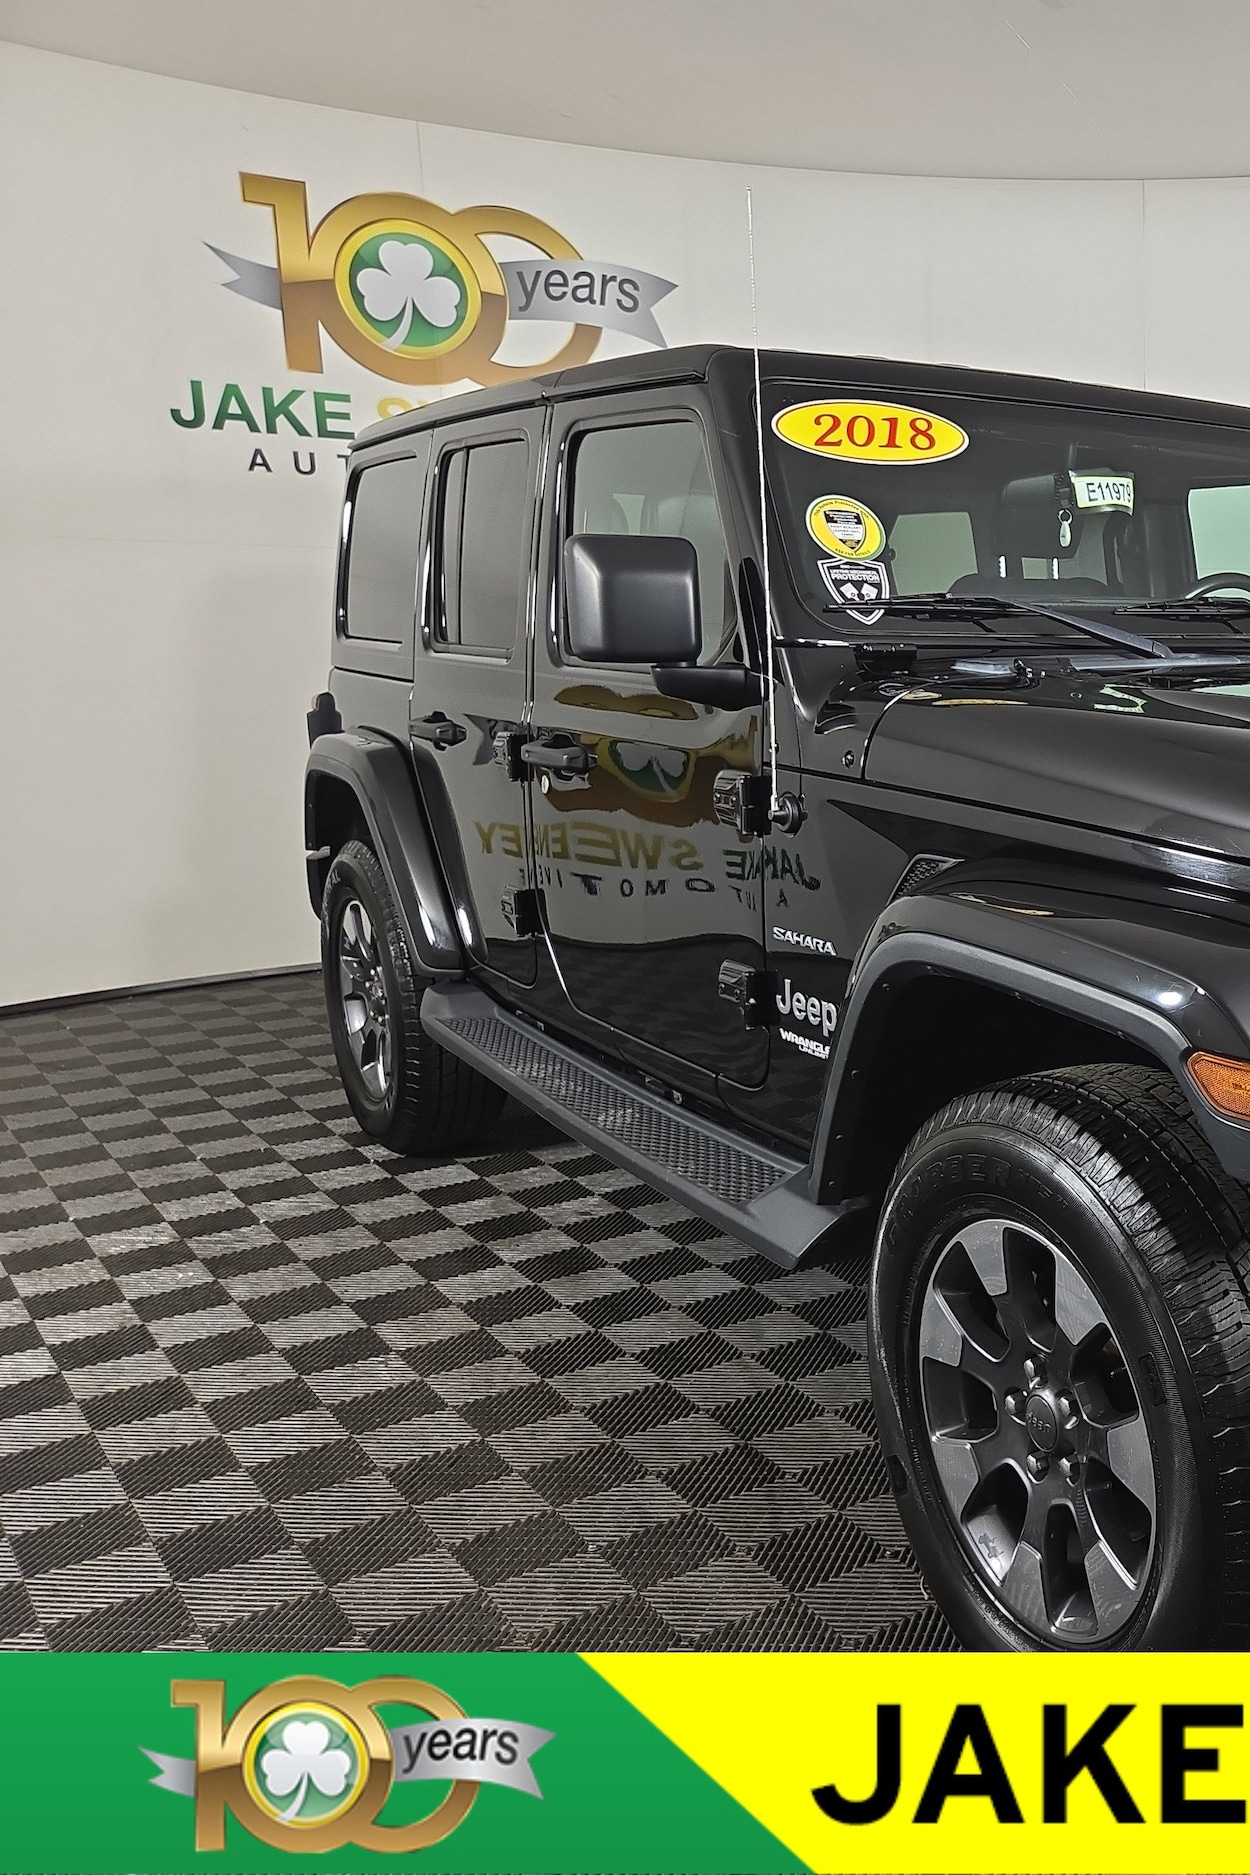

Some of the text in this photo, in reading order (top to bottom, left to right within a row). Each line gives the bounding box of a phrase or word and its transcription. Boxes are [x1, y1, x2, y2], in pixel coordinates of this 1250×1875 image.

[516, 264, 640, 314] years
[170, 380, 355, 441] JAKE
[814, 413, 937, 451] 2018
[1086, 481, 1132, 504] E11979
[831, 573, 880, 582] PROTECTION
[772, 926, 837, 956] SAHARA
[775, 978, 838, 1038] Jeep
[779, 1027, 831, 1056] WRANGLE
